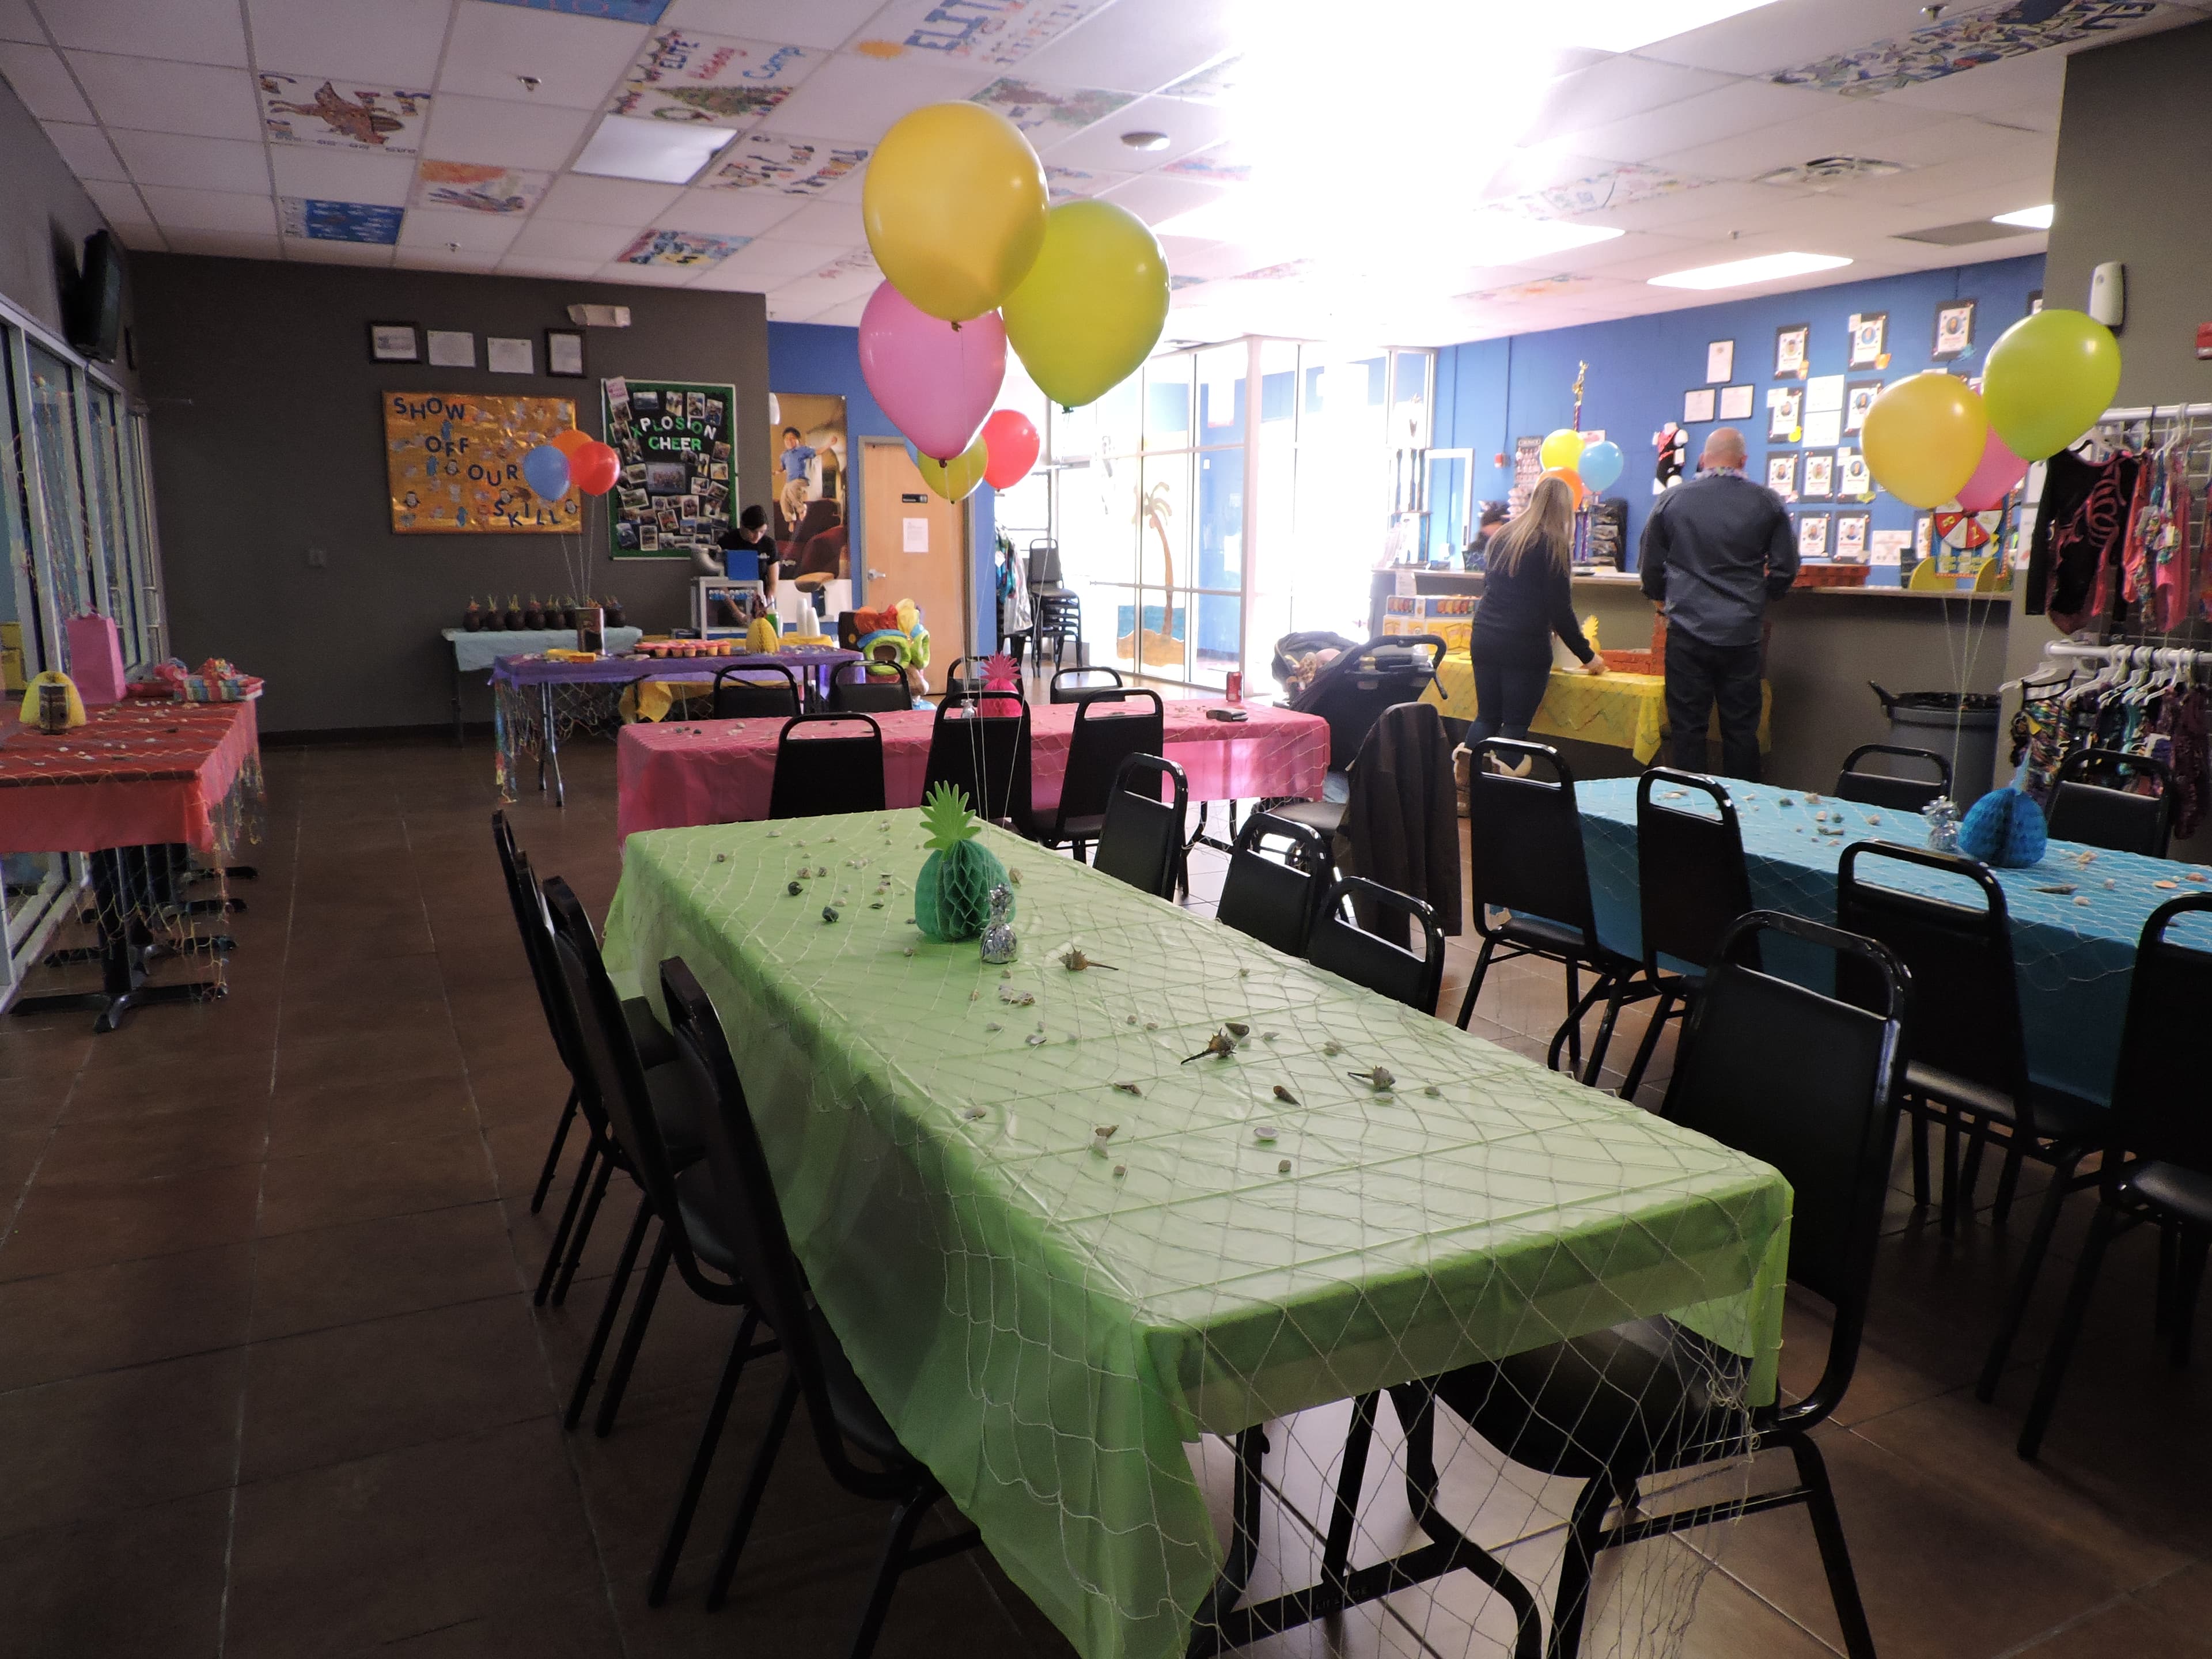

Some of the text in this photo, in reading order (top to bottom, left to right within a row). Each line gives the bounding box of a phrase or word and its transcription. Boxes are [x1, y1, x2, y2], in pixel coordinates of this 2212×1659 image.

[393, 397, 466, 421] SHOW
[425, 435, 469, 457] OFF
[648, 436, 702, 451] CHEER
[467, 463, 519, 487] OUR
[494, 501, 561, 528] SKILL
